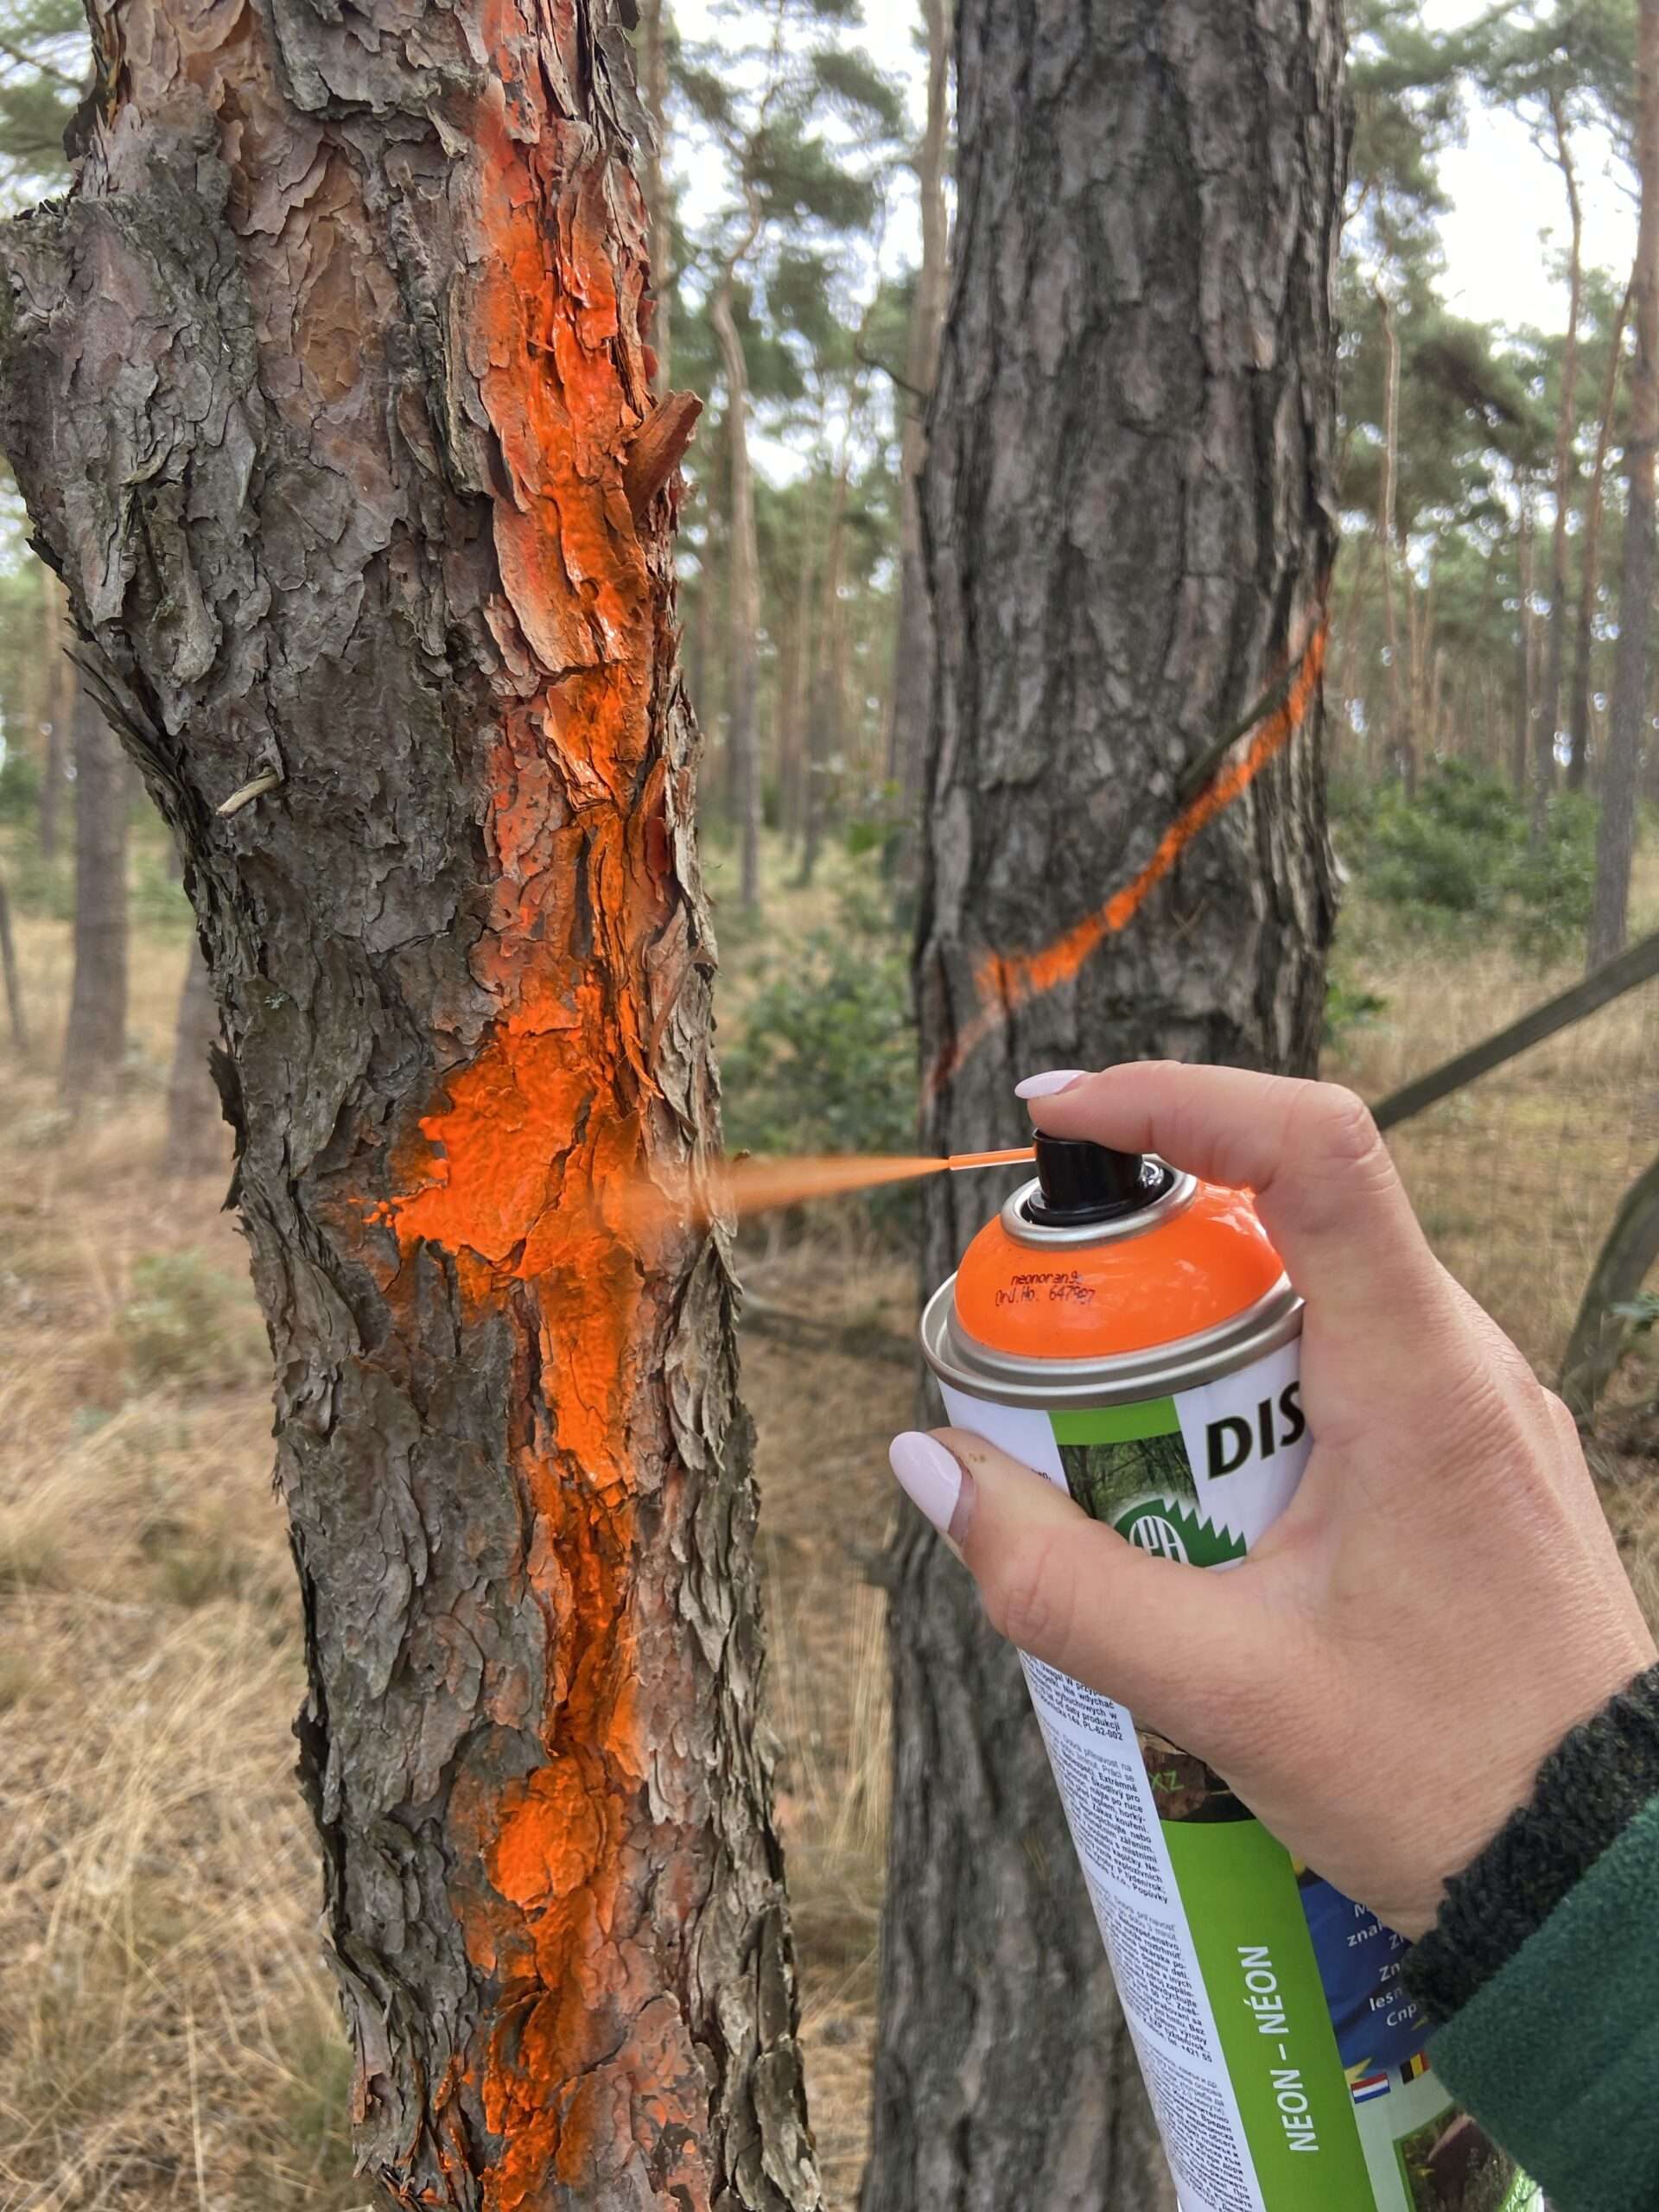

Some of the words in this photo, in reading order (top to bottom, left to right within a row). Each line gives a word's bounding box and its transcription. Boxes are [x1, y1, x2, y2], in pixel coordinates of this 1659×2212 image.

[1206, 1381, 1306, 1480] DIS
[1077, 1690, 1114, 1710] wdychać
[1081, 1710, 1120, 1731] produkcji
[1082, 1719, 1122, 1740] PL-62-002
[1120, 1761, 1131, 1770] na
[1125, 1792, 1140, 1803] pro
[1123, 1801, 1142, 1812] ruce
[1128, 1829, 1151, 1842] nebo
[1237, 1946, 1289, 2033] NÉON
[1187, 2022, 1205, 2036] Bez
[1191, 2016, 1202, 2026] sa
[1270, 2069, 1319, 2152] NEON
